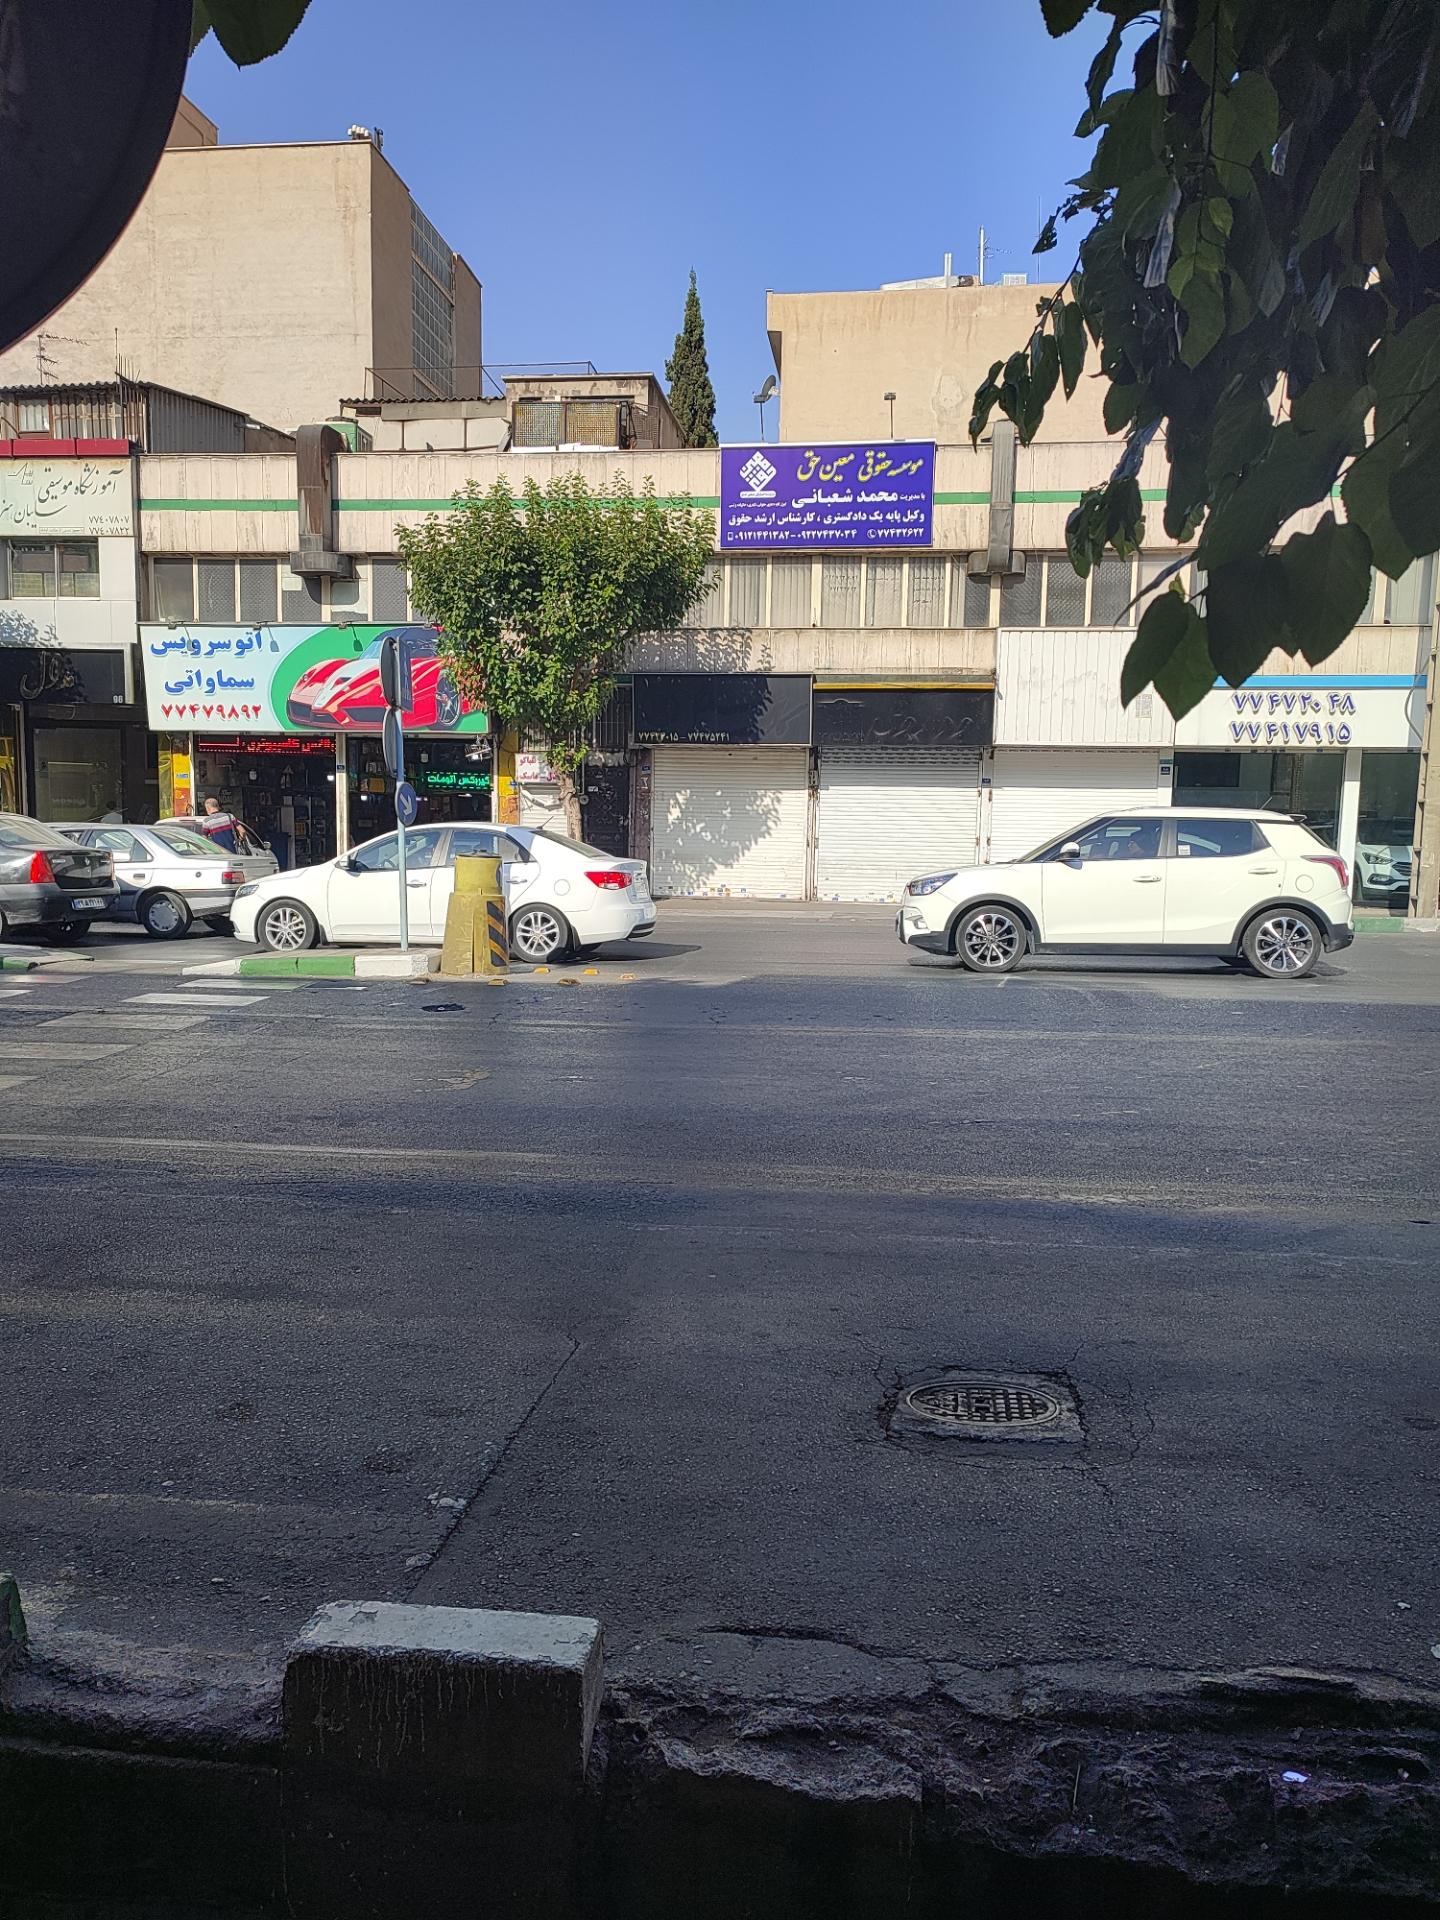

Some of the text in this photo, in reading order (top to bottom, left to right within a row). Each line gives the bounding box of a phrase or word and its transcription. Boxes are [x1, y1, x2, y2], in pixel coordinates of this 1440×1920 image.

[796, 449, 822, 482] حق
[819, 451, 856, 482] معین
[857, 449, 892, 481] حقوقی
[37, 467, 73, 504] موسیقی
[74, 462, 124, 495] آموزشگاه
[791, 487, 853, 508] شعبانی
[856, 488, 898, 503] محمد
[899, 493, 920, 502] مدیریت
[728, 512, 752, 527] حقوق
[754, 512, 776, 527] ارشد
[777, 511, 816, 526] کارشناس
[869, 510, 884, 524] یک
[885, 509, 902, 524] پایه
[903, 509, 925, 523] وکیل
[164, 669, 255, 695] سماواتی
[161, 703, 262, 721] ۷۷۴۷۹۸۹۲
[427, 773, 457, 785] اتومات
